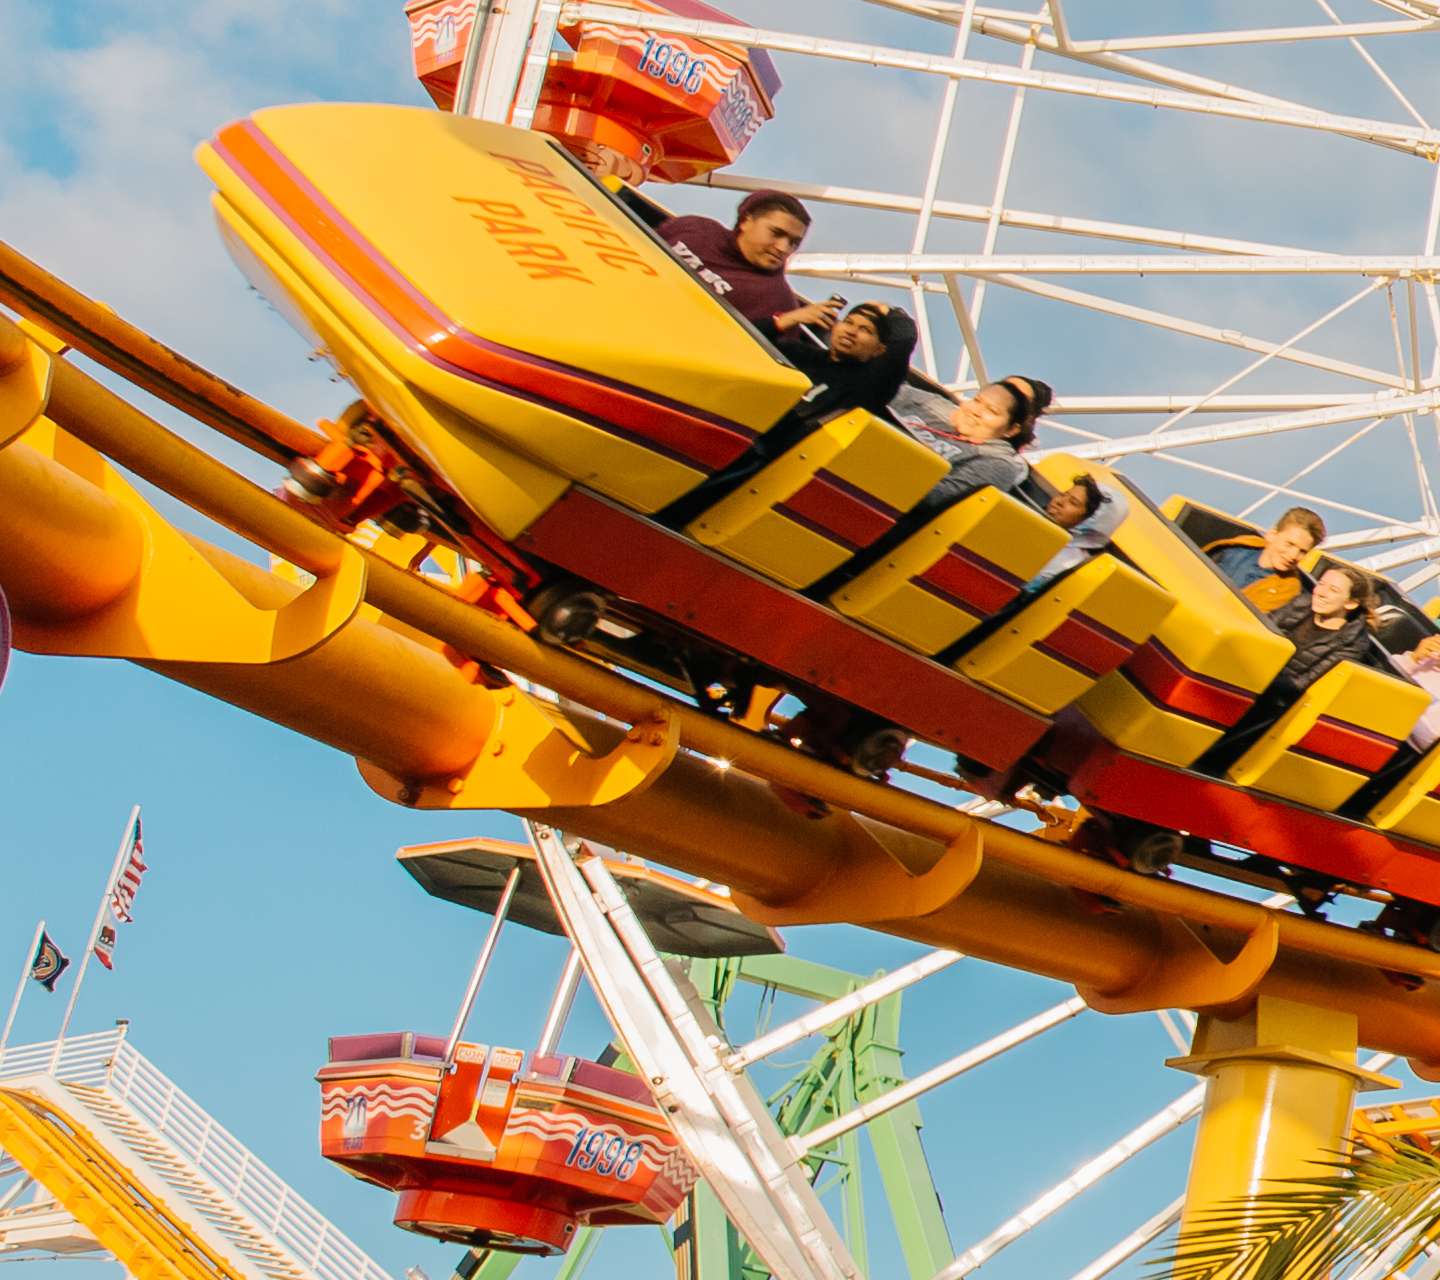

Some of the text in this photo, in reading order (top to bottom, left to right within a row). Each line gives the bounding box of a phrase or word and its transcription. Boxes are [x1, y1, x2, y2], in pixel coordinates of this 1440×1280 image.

[638, 36, 707, 95] 1996
[452, 196, 597, 286] PARK
[487, 150, 660, 281] PACIFIC
[410, 1119, 426, 1140] 3
[566, 1127, 644, 1181] 1998
